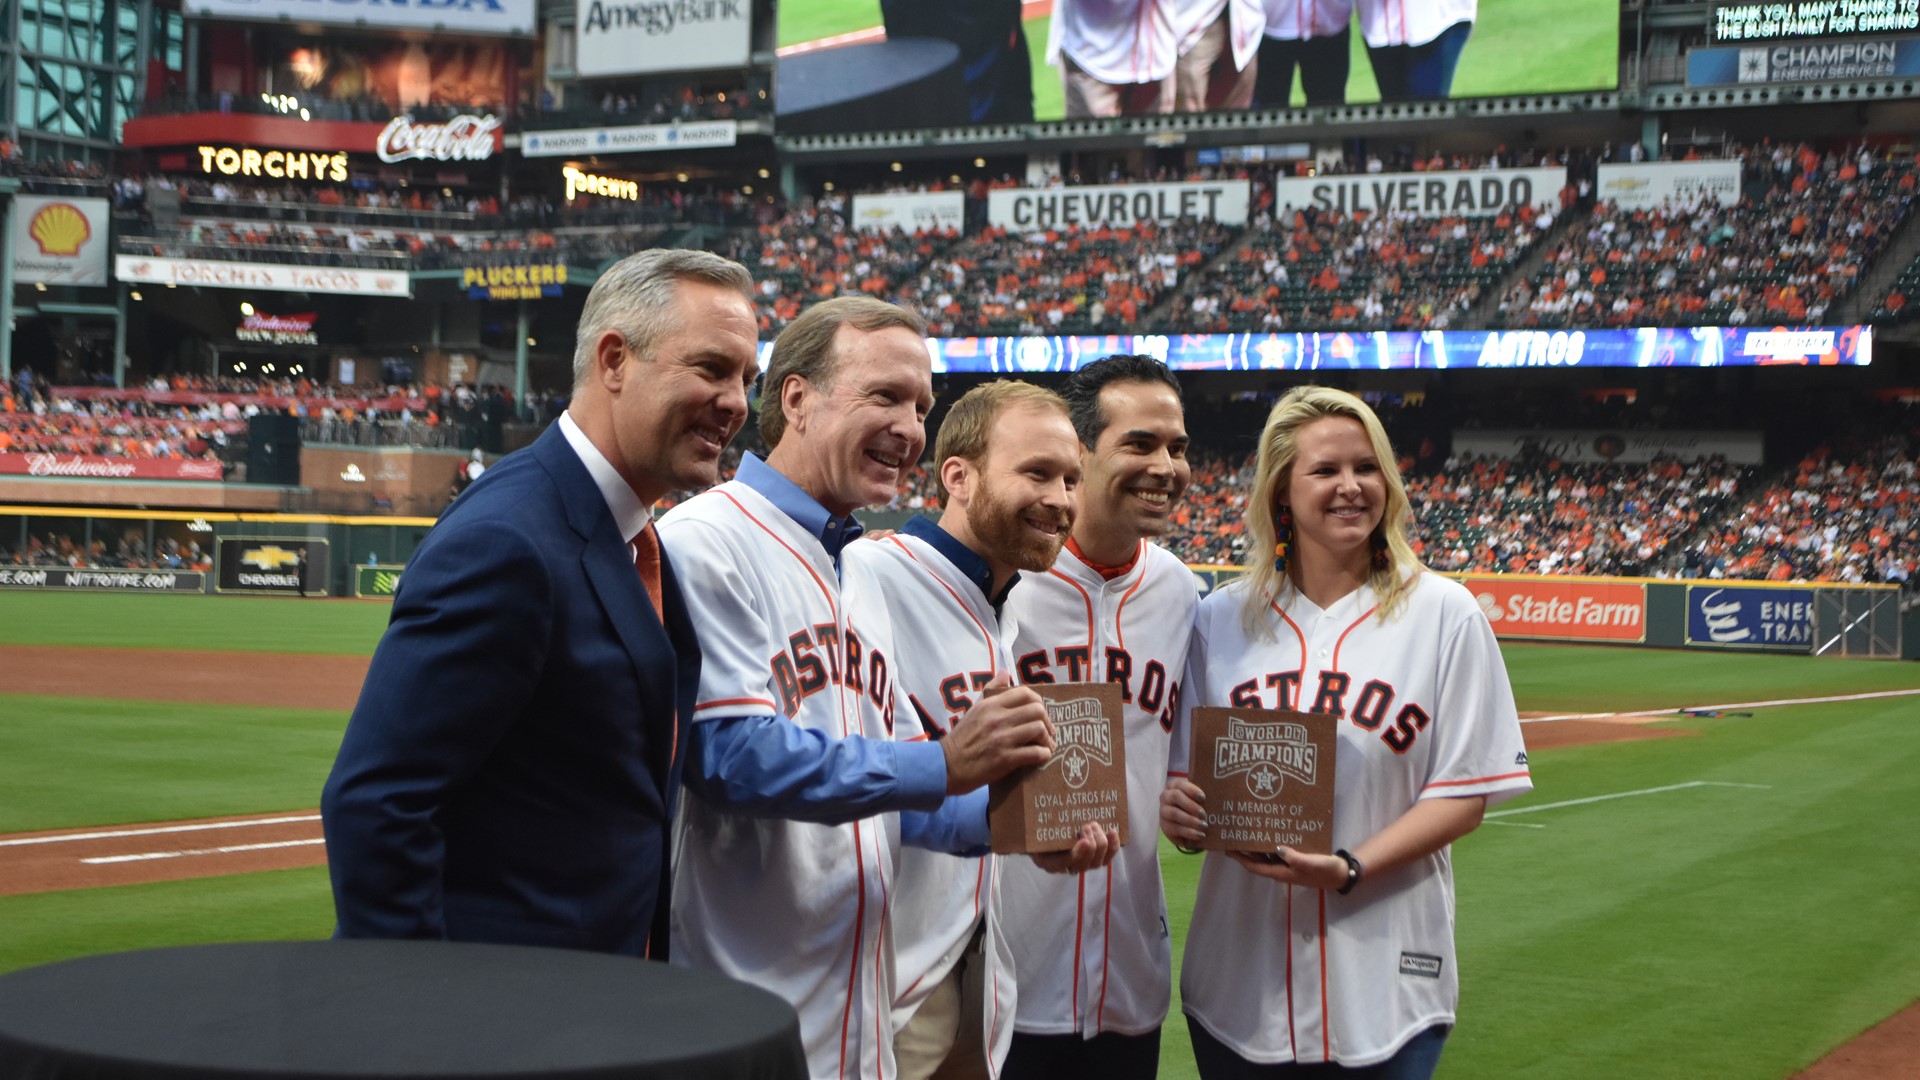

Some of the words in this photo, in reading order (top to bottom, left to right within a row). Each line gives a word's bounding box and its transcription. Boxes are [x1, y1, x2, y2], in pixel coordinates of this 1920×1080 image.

[584, 0, 741, 35] AmegyBank
[1716, 5, 1761, 24] THANK
[1798, 1, 1837, 19] MANY
[1841, 0, 1895, 17] THANKS
[1899, 0, 1919, 13] TO
[1716, 22, 1742, 40] THE
[1744, 20, 1779, 38] BUSH
[1781, 17, 1826, 36] FAMILY
[1829, 15, 1856, 34] FOR
[1858, 13, 1919, 32] SHARING
[1771, 41, 1896, 69] CHAMPION
[1771, 65, 1826, 82] ENERGY
[1828, 63, 1895, 80] SERVICES
[1312, 177, 1532, 211] SILVERADO
[1013, 188, 1223, 225] CHEVROLET
[291, 269, 361, 290] TACOS
[464, 264, 567, 287] PLUCKERS
[1477, 331, 1587, 367] ASTROS
[24, 452, 136, 477] Budweiser
[65, 571, 176, 589] NITTOTIRE.COM
[770, 623, 895, 736] ASTROS
[1017, 645, 1180, 733] STROS
[1055, 701, 1091, 722] WORLD
[1229, 670, 1431, 755] STROS
[1055, 724, 1109, 754] AMPIONS
[1245, 725, 1293, 740] WORLD
[1218, 742, 1314, 774] CHAMPIONS
[1034, 794, 1063, 808] LOYAL
[1066, 790, 1099, 806] ASTROS
[1100, 789, 1118, 803] FAN
[1223, 800, 1233, 811] IN
[1237, 801, 1286, 815] MEMORY
[1289, 805, 1303, 816] OF
[1058, 810, 1069, 822] US
[1071, 806, 1116, 821] PRESIDENT
[1205, 813, 1262, 828] OUSTON'S
[1264, 817, 1292, 829] FIRST
[1295, 820, 1325, 832] LADY
[1036, 826, 1072, 841] GEORGE
[1220, 829, 1271, 842] BARBARA
[1274, 833, 1303, 845] BUSH
